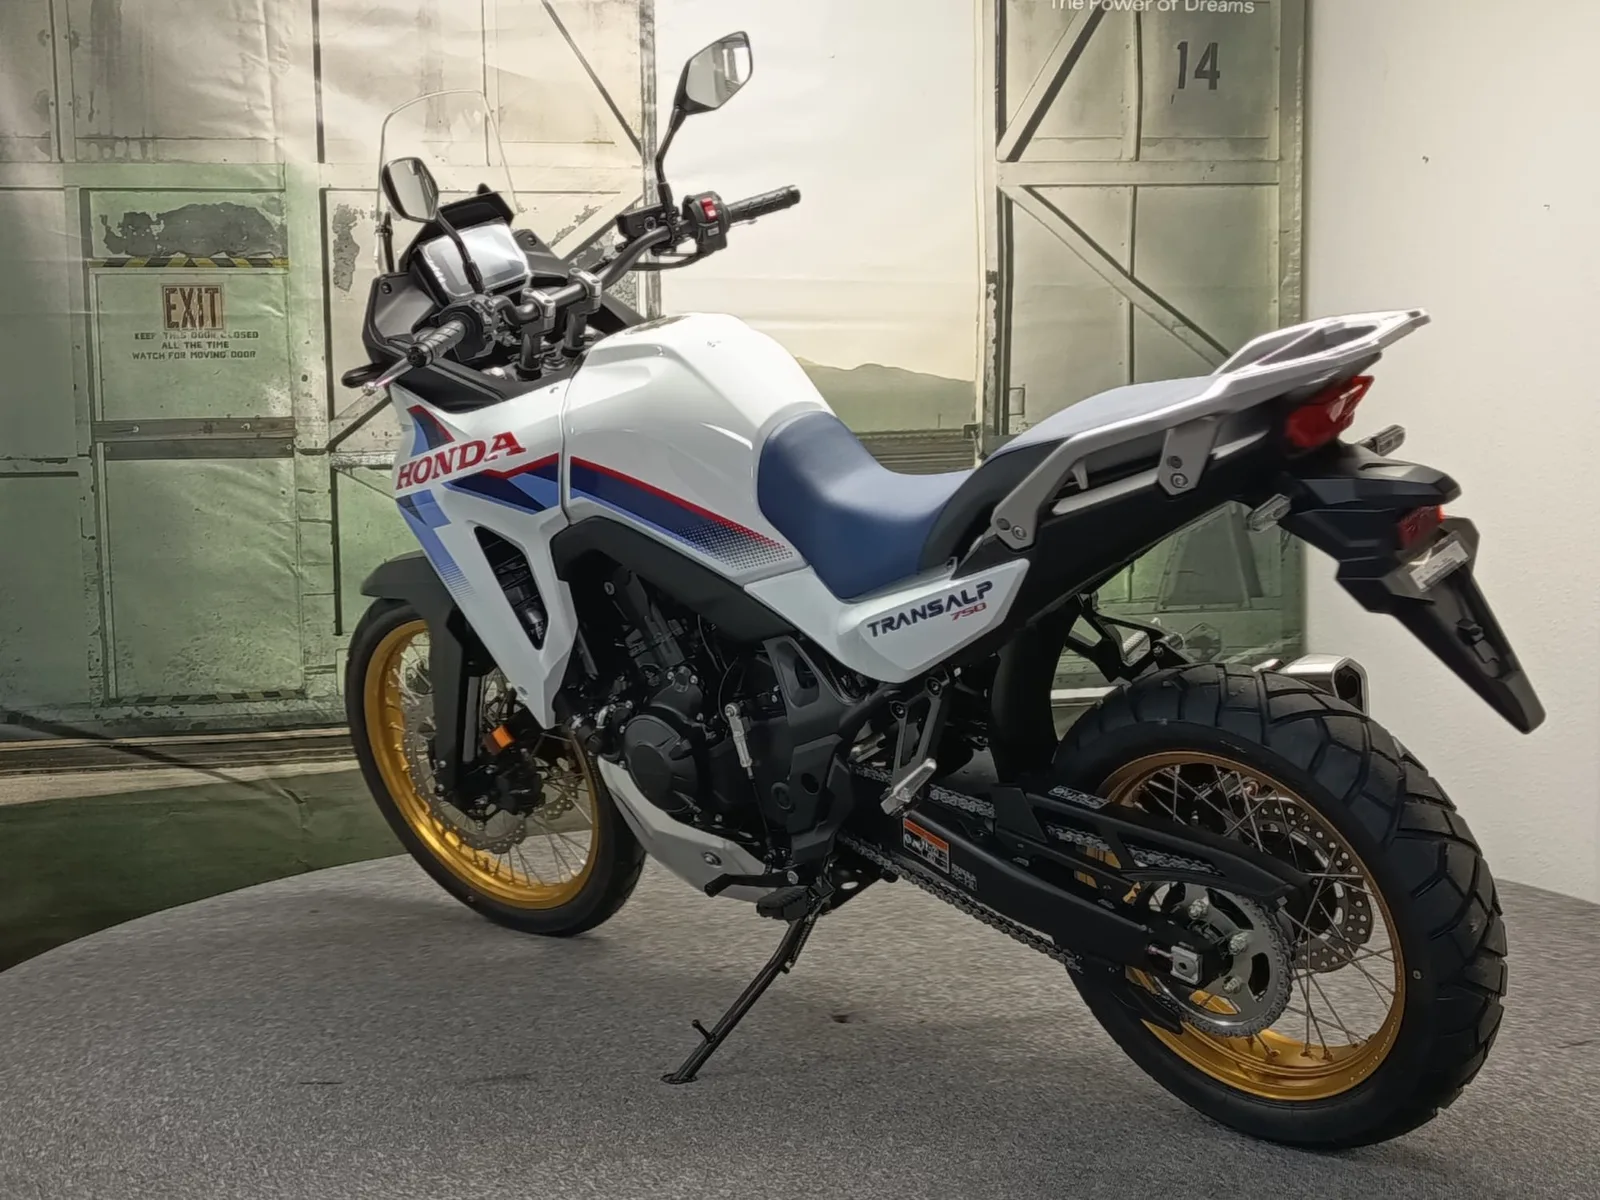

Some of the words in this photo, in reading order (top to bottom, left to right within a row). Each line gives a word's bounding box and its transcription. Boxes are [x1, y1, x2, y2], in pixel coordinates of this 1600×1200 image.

[1051, 0, 1083, 10] The
[1089, 0, 1150, 12] Power
[1157, 0, 1177, 11] of
[1185, 0, 1255, 14] Dreams
[1177, 41, 1221, 90] 14
[165, 287, 219, 329] EXIT
[134, 332, 156, 340] KEEP
[161, 341, 179, 349] ALL
[184, 341, 203, 349] THE
[206, 341, 230, 349] TIME
[132, 351, 165, 360] WATCH
[168, 351, 186, 360] FOR
[190, 351, 227, 359] MOVING
[231, 351, 256, 359] DOOR
[396, 431, 527, 490] HONDA
[867, 581, 993, 638] TRANSALP
[951, 602, 987, 621] 750
